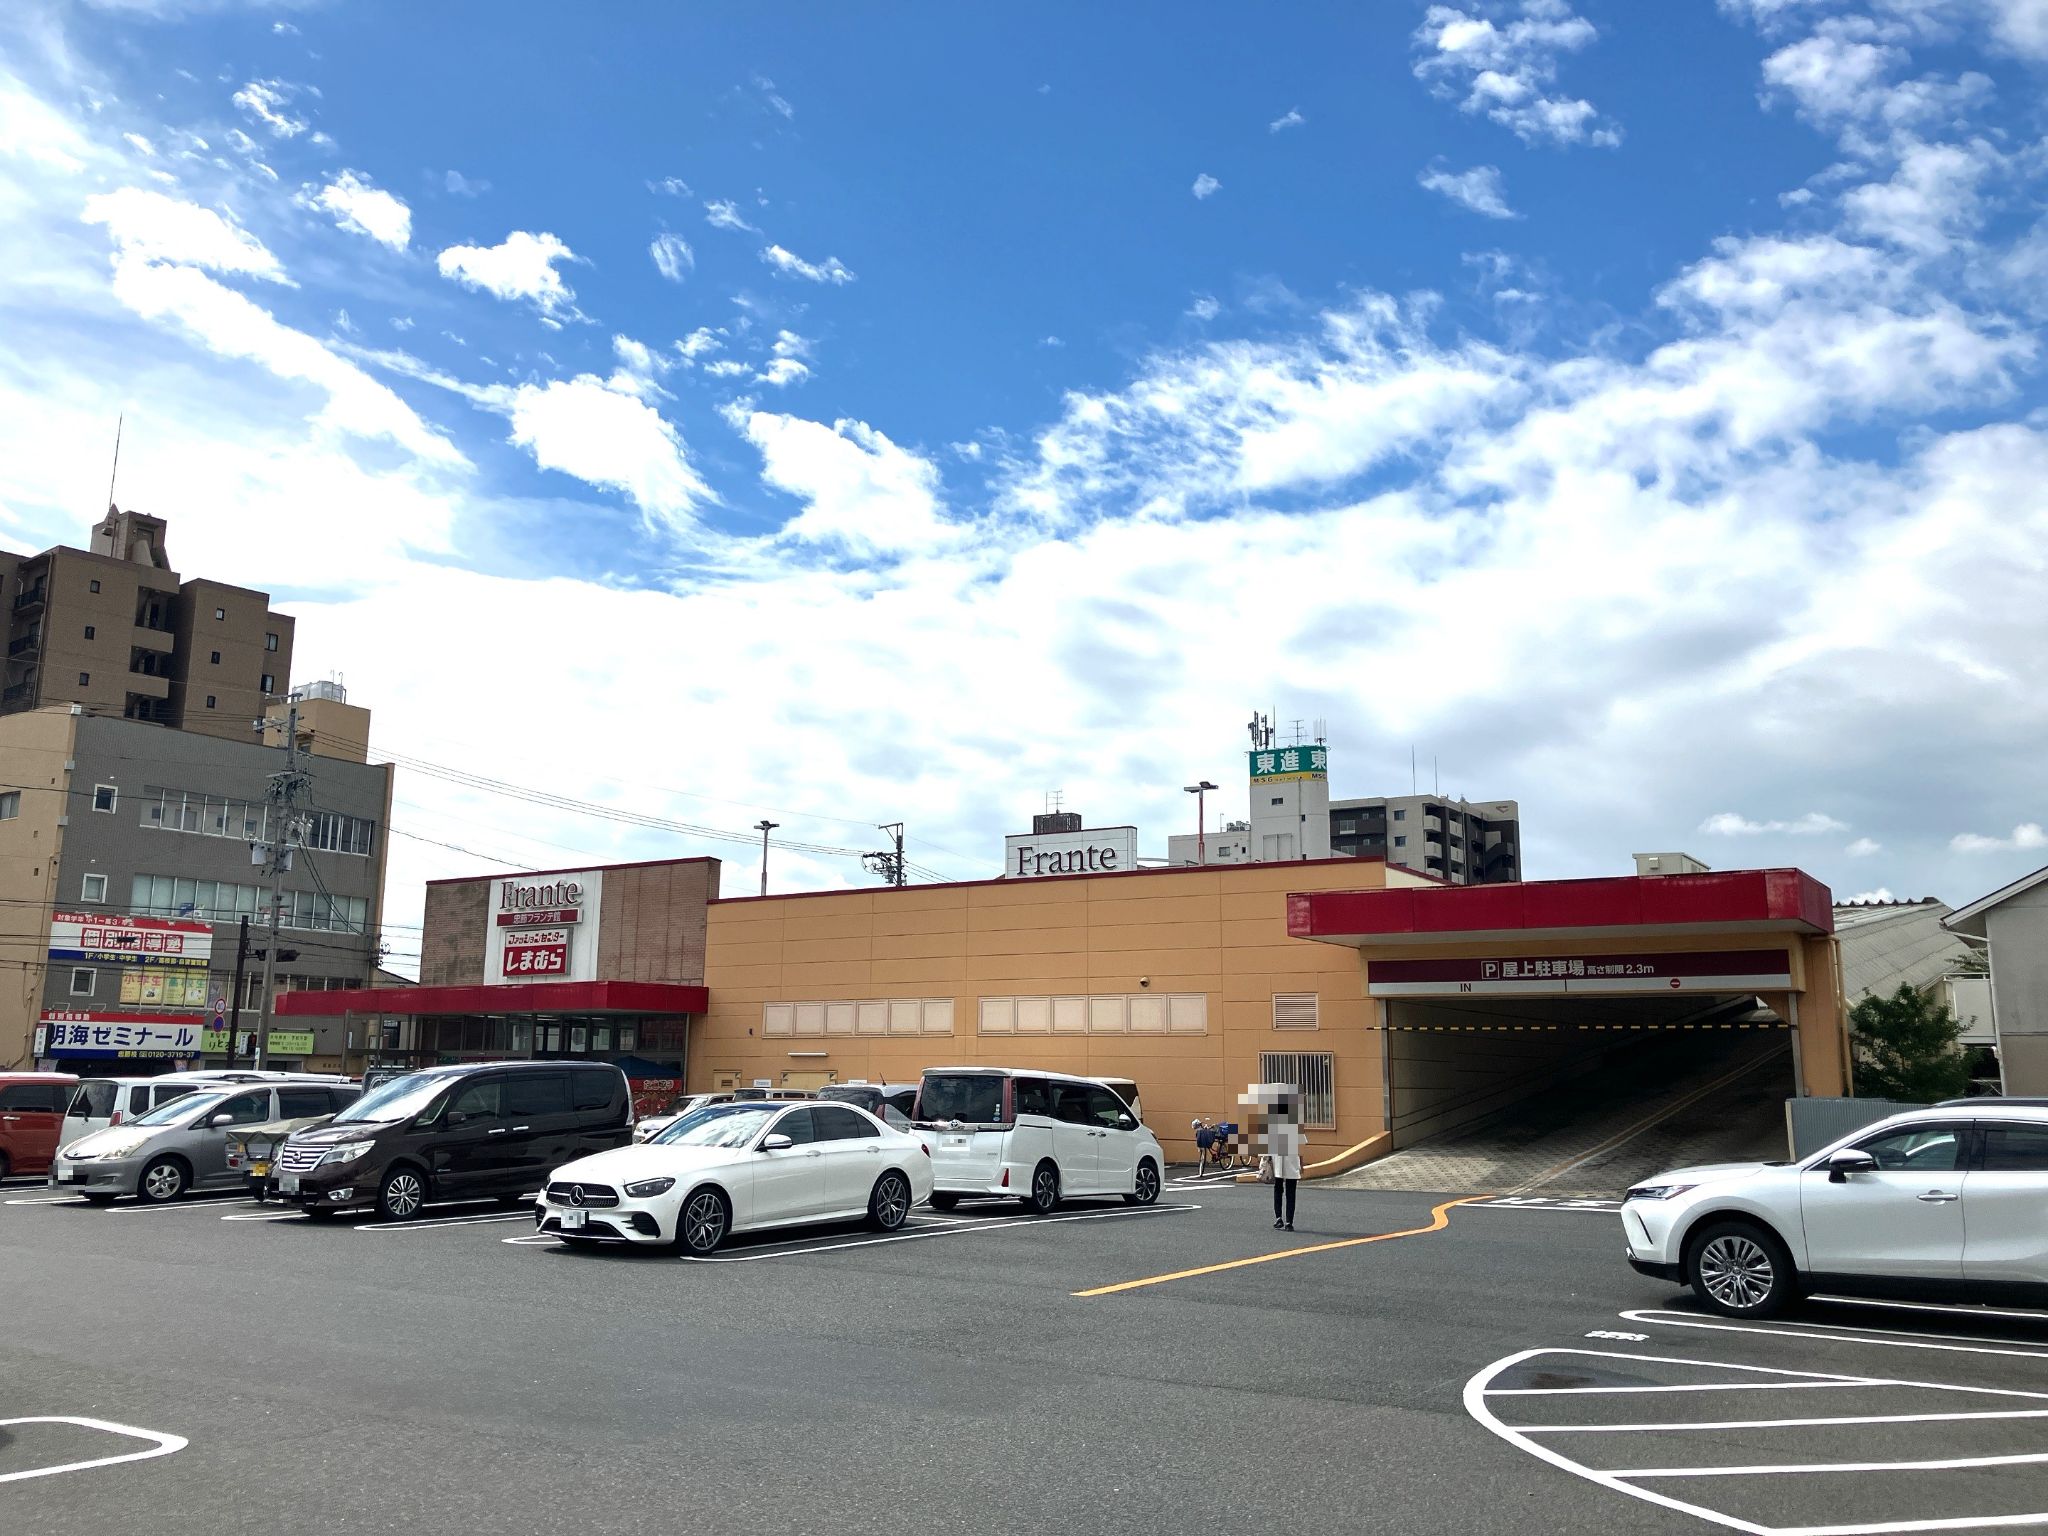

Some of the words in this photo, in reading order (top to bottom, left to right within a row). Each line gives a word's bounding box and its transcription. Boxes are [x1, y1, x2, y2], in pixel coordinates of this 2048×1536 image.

[1256, 749, 1299, 774] 東進
[1310, 749, 1327, 770] 東
[1016, 845, 1117, 876] Frante
[499, 880, 581, 909] Frante
[513, 911, 561, 924] 忠節フランテ館
[508, 931, 564, 945] ファッションセンター
[506, 948, 564, 972] しまむら
[1502, 959, 1585, 977] 屋上駐車場
[1587, 964, 1625, 975] 高さ制限
[1626, 963, 1655, 974] 2.3m
[1460, 983, 1472, 992] IN
[51, 1024, 194, 1047] 明海ゼミナール
